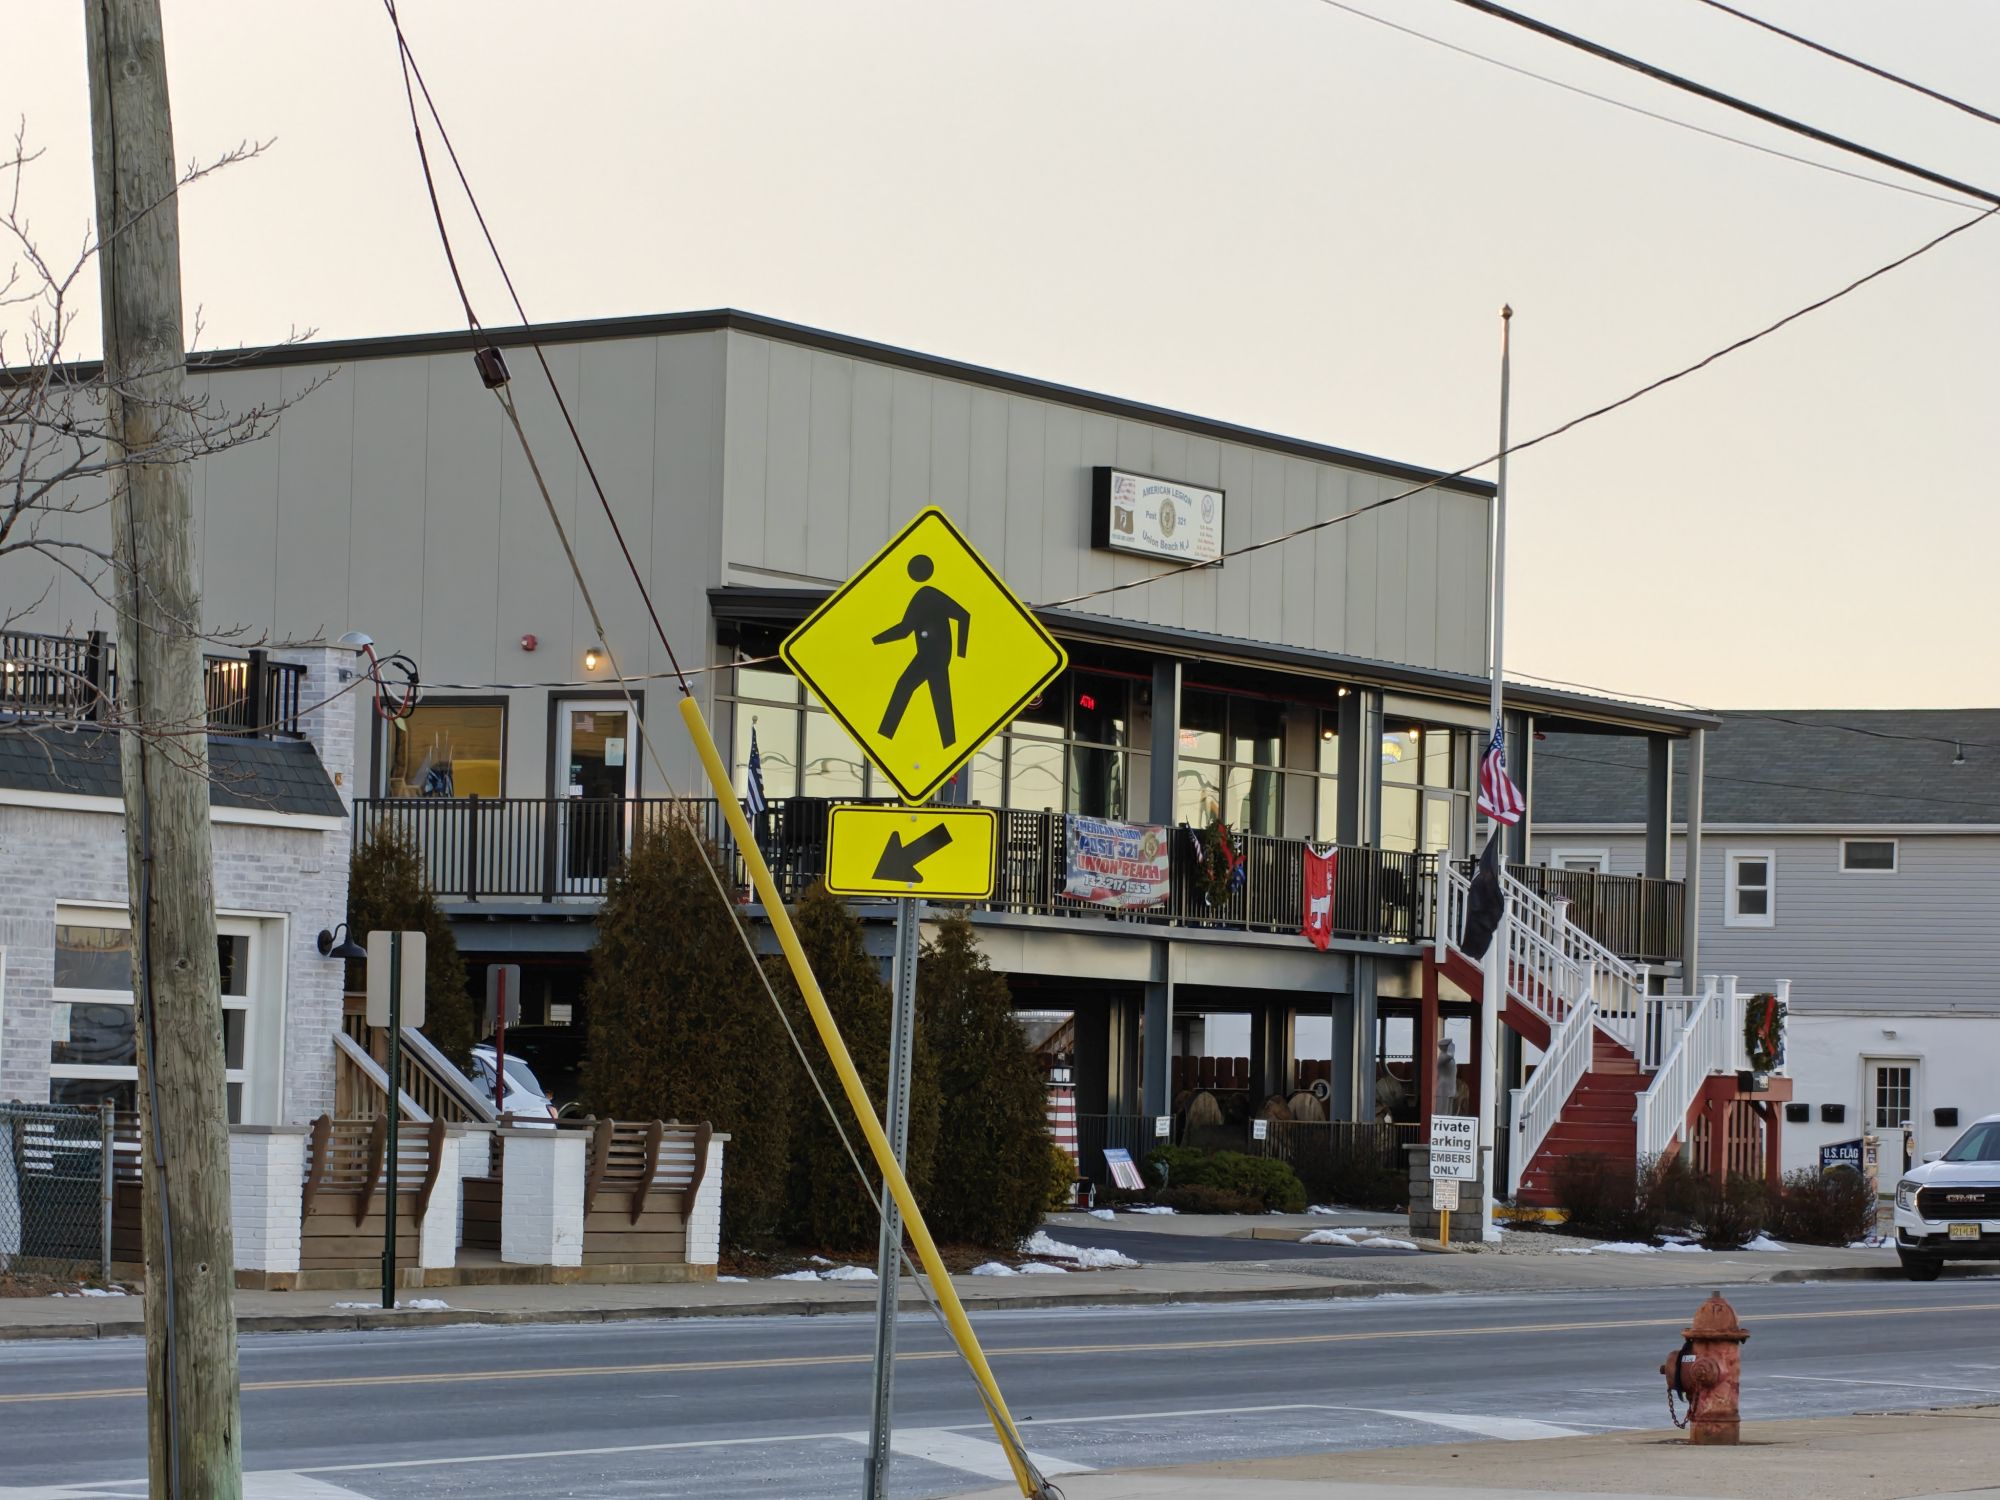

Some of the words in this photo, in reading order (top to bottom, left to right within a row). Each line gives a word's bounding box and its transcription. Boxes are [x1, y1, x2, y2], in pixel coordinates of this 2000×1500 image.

[1142, 485, 1171, 498] AMERICAN
[1172, 490, 1192, 508] LEGION
[1146, 511, 1157, 521] Post
[1142, 530, 1160, 547] Union
[1160, 540, 1178, 551] Beach
[1079, 835, 1115, 856] POST
[1118, 841, 1139, 860] 321
[1077, 854, 1119, 875] UNION
[1121, 861, 1160, 880] BEACH
[1823, 1147, 1839, 1159] U.S.
[1840, 1148, 1859, 1159] FLAG
[1433, 1165, 1460, 1176] ONLY
[1946, 1194, 1985, 1202] GMC
